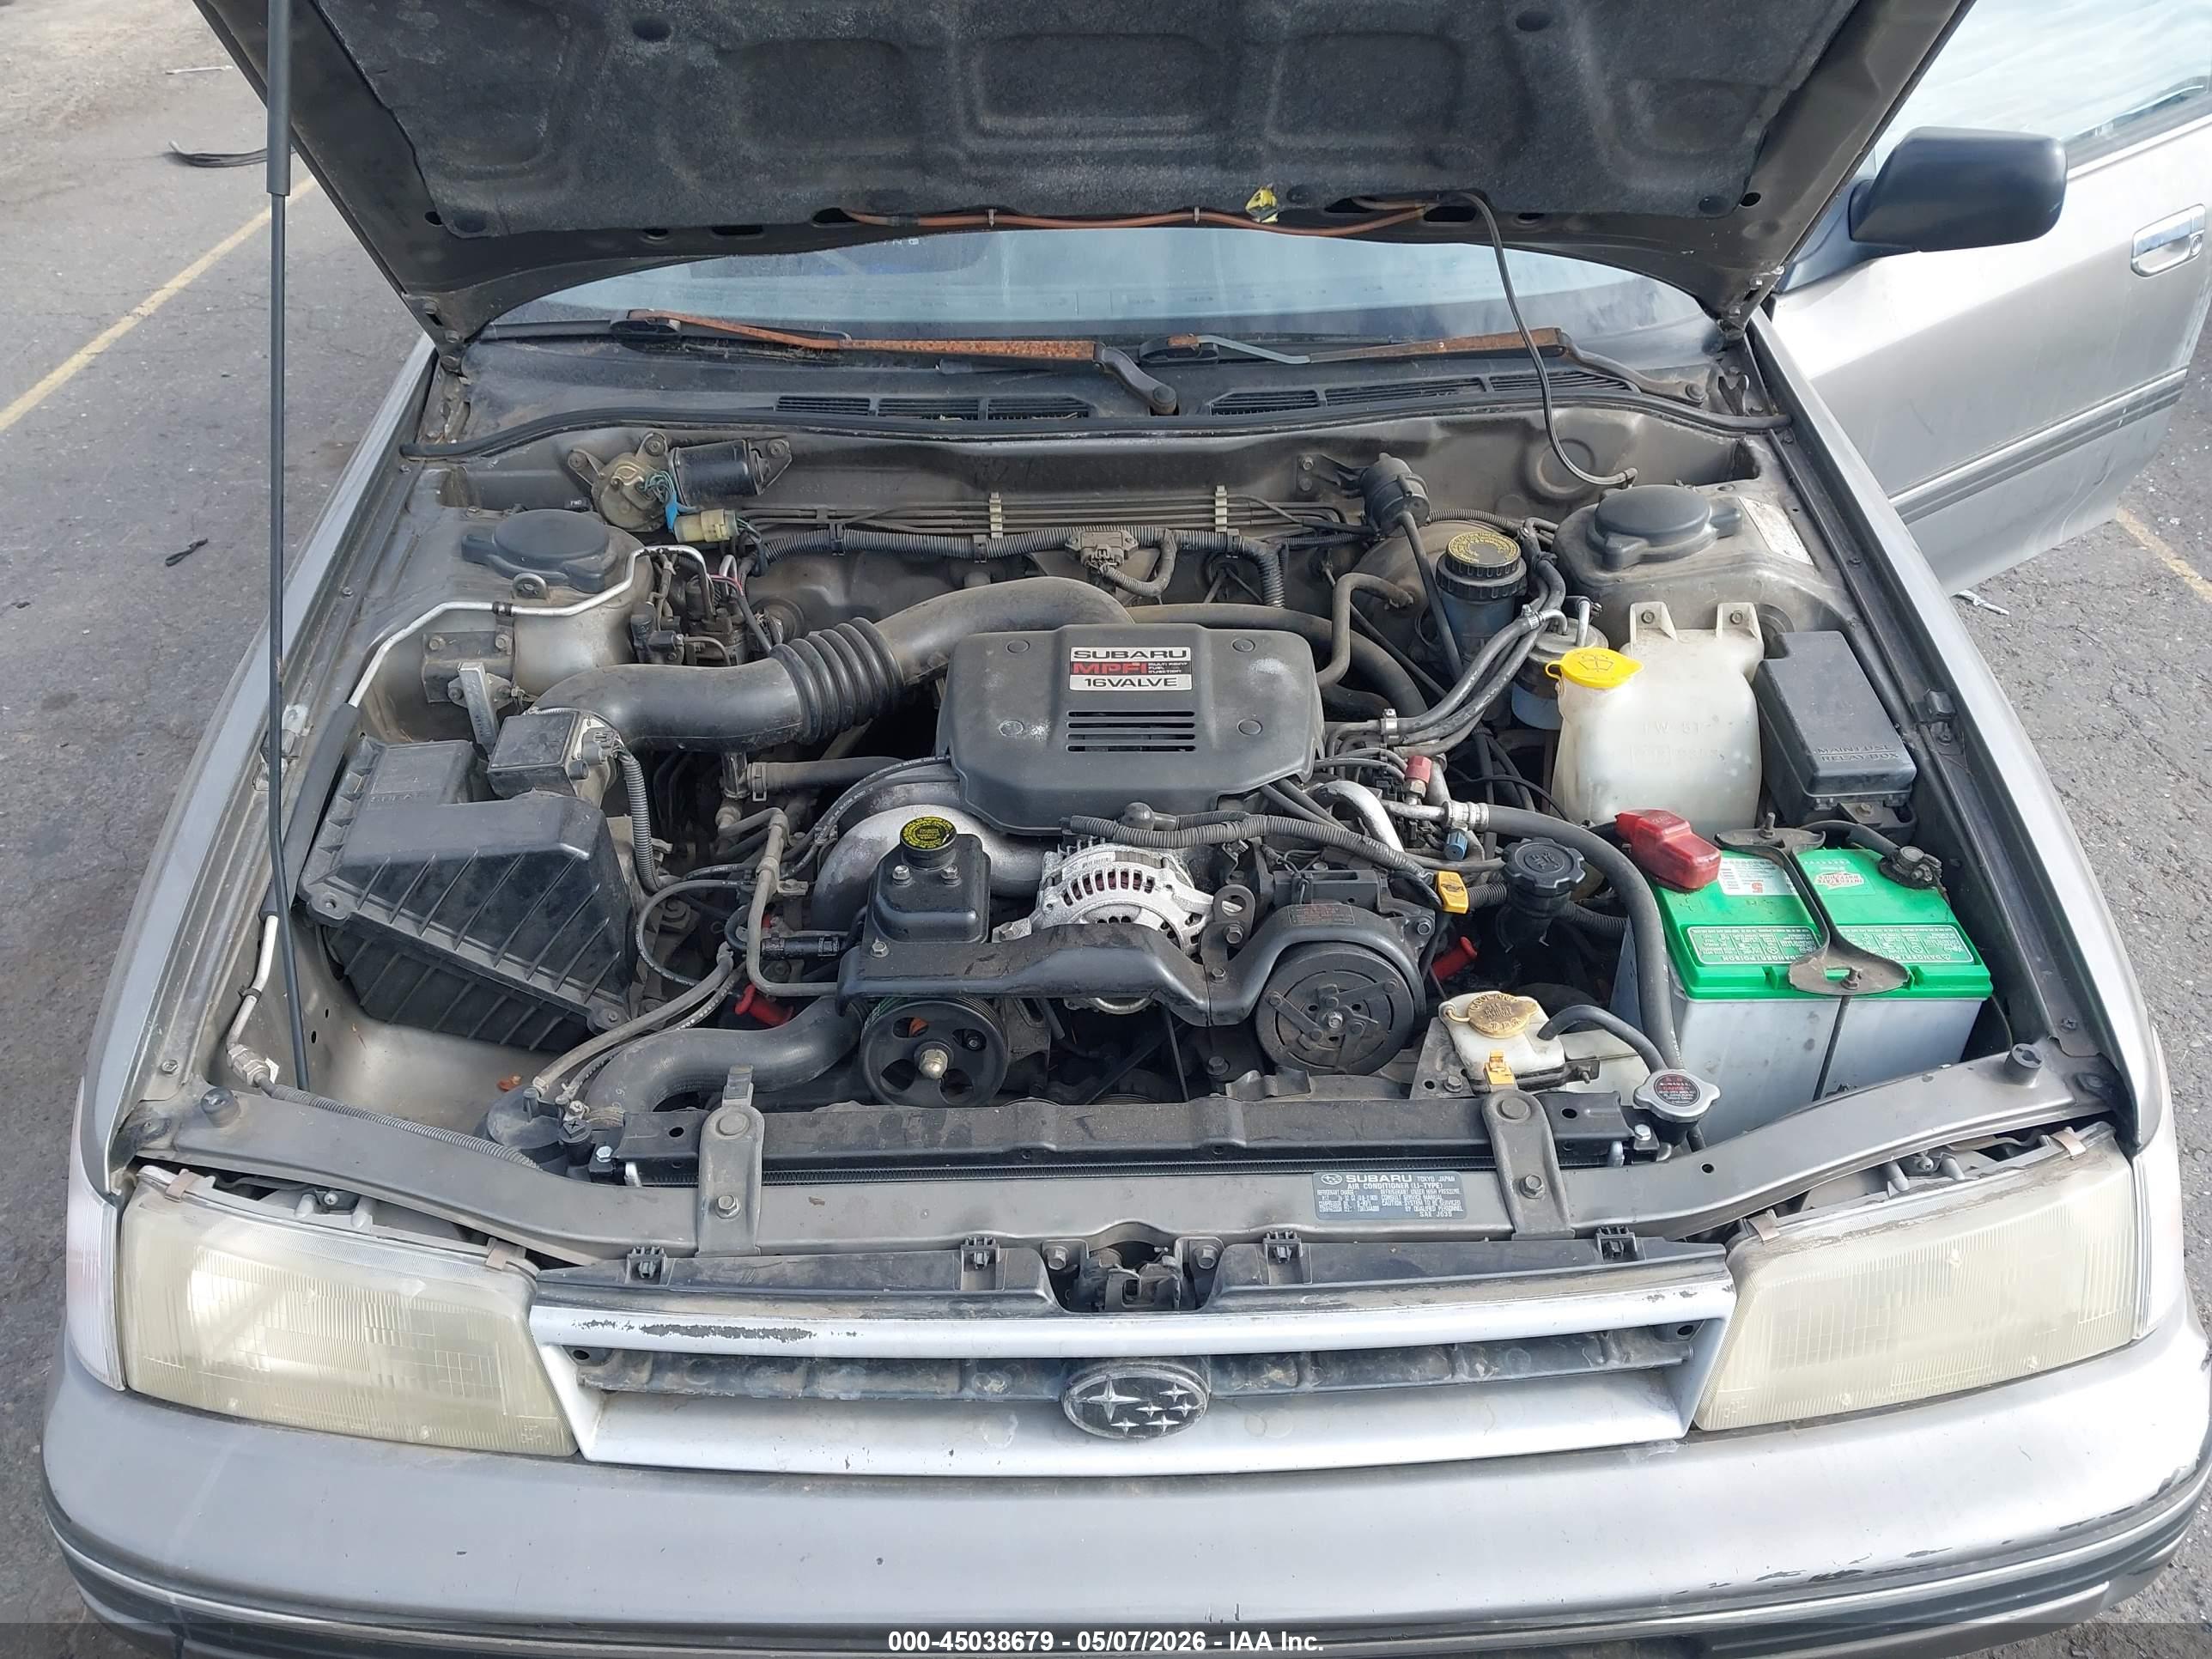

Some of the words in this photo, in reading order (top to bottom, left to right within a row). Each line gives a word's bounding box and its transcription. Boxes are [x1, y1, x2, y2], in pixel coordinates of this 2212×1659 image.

[1073, 650, 1187, 659] SUBARU
[1073, 662, 1147, 674] MPFI
[1085, 678, 1178, 687] 16VALVE
[1346, 1174, 1413, 1182] SUBARU
